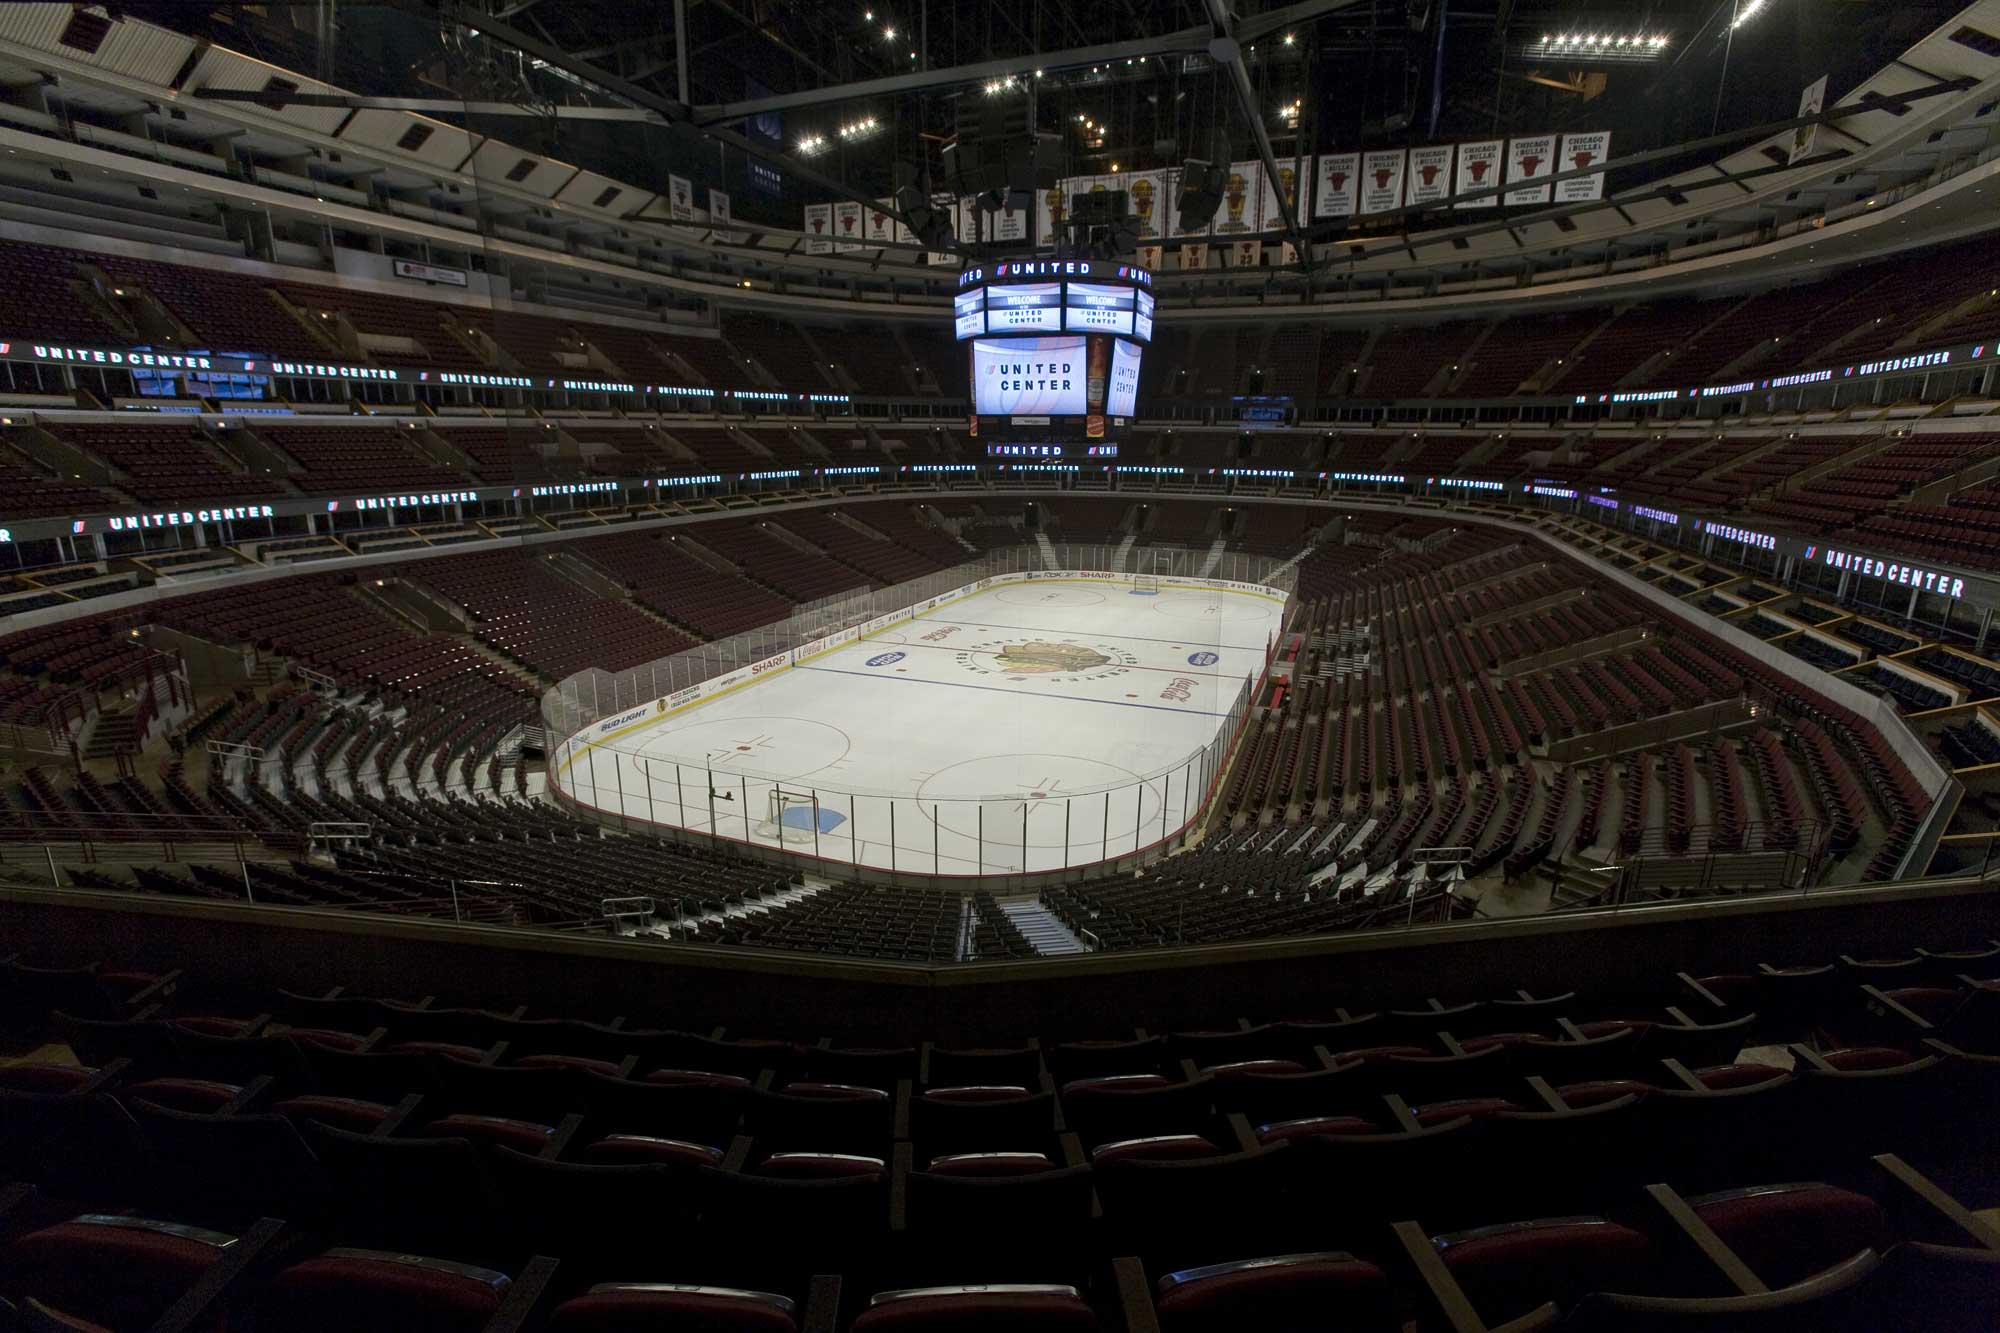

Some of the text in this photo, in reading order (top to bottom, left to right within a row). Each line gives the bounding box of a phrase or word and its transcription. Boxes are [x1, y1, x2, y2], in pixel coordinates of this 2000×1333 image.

[1515, 140, 1549, 149] CHICAGO
[1568, 136, 1603, 145] CHICAGO
[1012, 263, 1090, 275] UNITED
[1007, 295, 1041, 305] WELCOME
[1085, 295, 1117, 306] WELCOME
[33, 345, 212, 370] UNITED CENTER
[1859, 351, 1950, 375] UNITED CENTER
[272, 362, 398, 380] UNITED CENTER
[1000, 363, 1071, 375] UNITED
[1118, 366, 1136, 379] UNITED
[1001, 379, 1071, 391] CENTER
[1116, 381, 1134, 394] CENTER
[1003, 446, 1062, 455] UNITED
[108, 505, 274, 531] UNITED CENTER
[1825, 549, 1964, 598] UNITED CENTER
[751, 655, 786, 675] SHARP
[600, 708, 648, 732] BUD LIGHT
